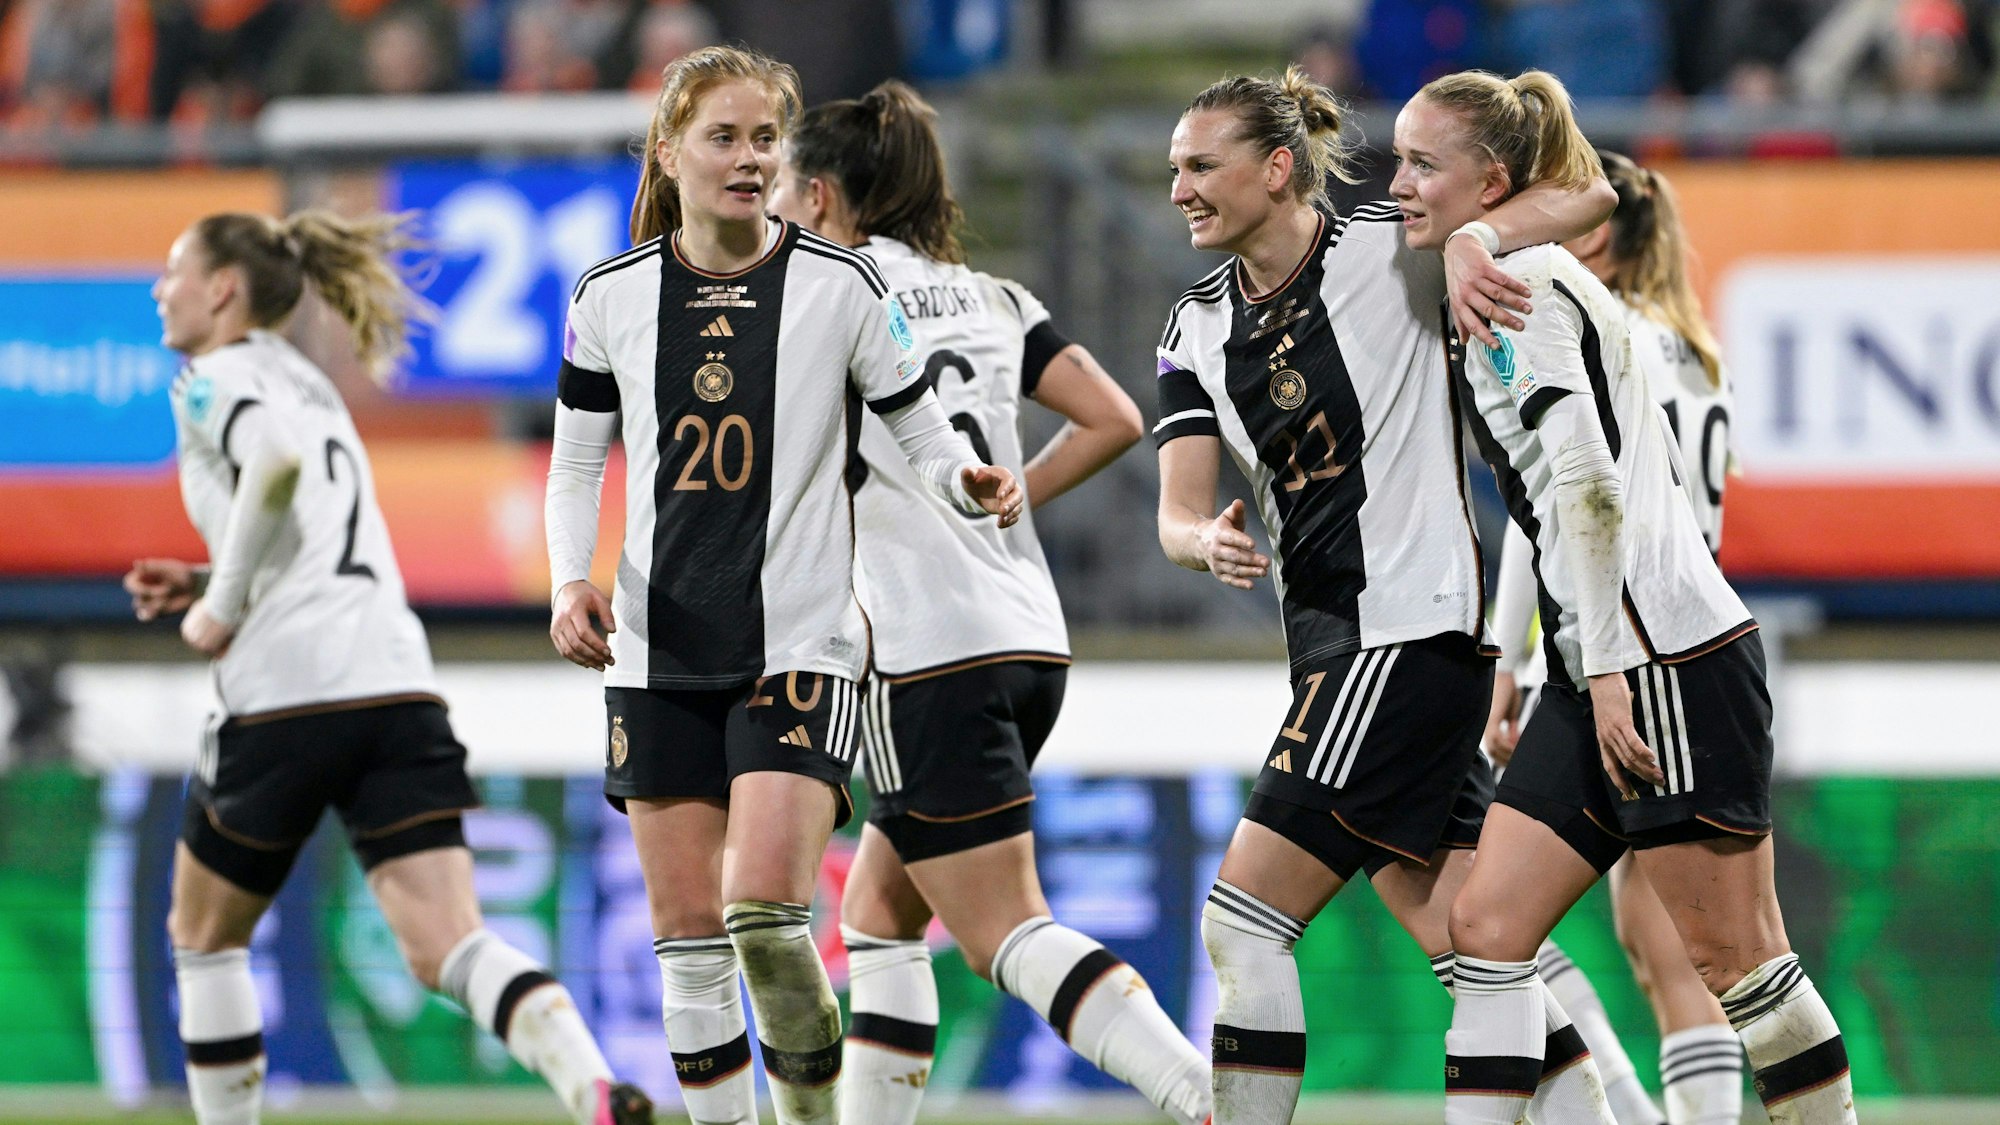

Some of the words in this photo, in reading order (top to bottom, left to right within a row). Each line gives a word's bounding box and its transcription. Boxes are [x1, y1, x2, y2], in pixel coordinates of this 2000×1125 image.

[436, 180, 621, 375] 21
[673, 414, 754, 492] 20
[1268, 410, 1347, 492] 11
[325, 438, 378, 581] 2
[1281, 671, 1327, 743] 1
[1212, 1036, 1238, 1051] FB
